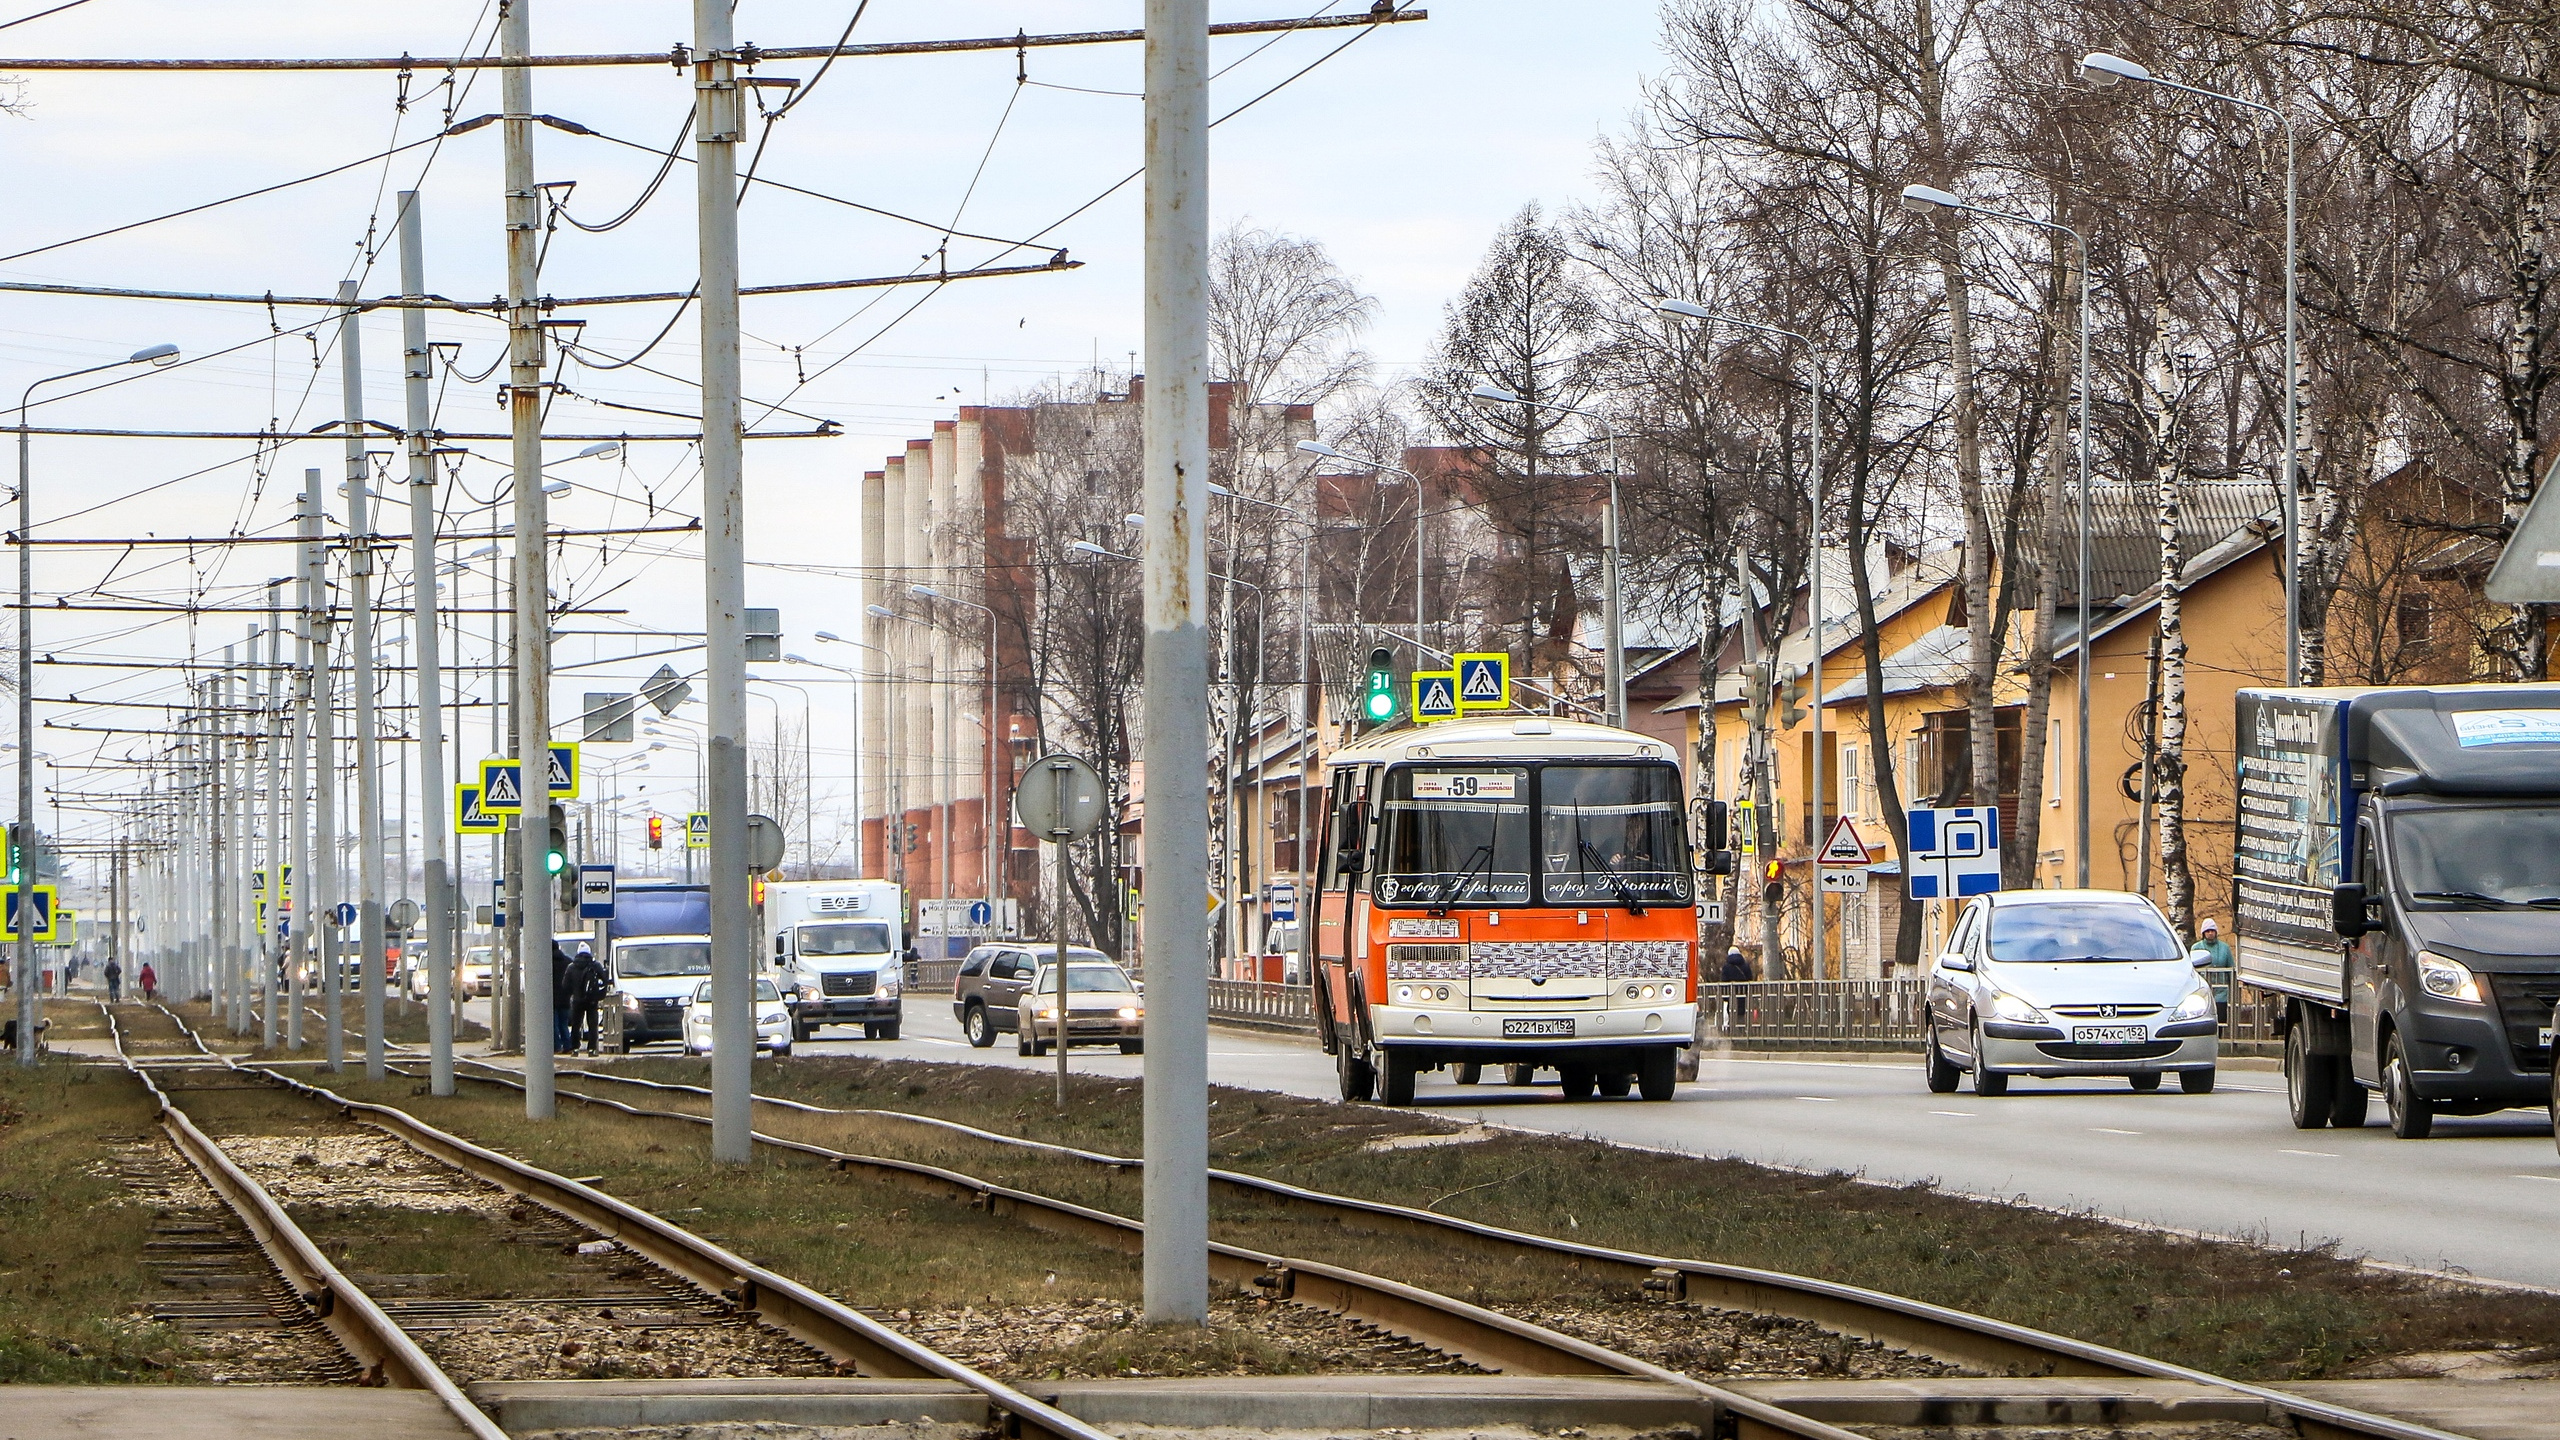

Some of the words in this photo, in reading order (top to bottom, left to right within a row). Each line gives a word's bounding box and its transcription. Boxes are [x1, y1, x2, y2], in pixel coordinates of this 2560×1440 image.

[1373, 672, 1390, 690] 31
[1841, 875, 1855, 886] 10
[1400, 881, 1441, 898] город
[1549, 880, 1589, 898] город
[1555, 1020, 1572, 1030] 152
[2127, 1027, 2143, 1037] 152
